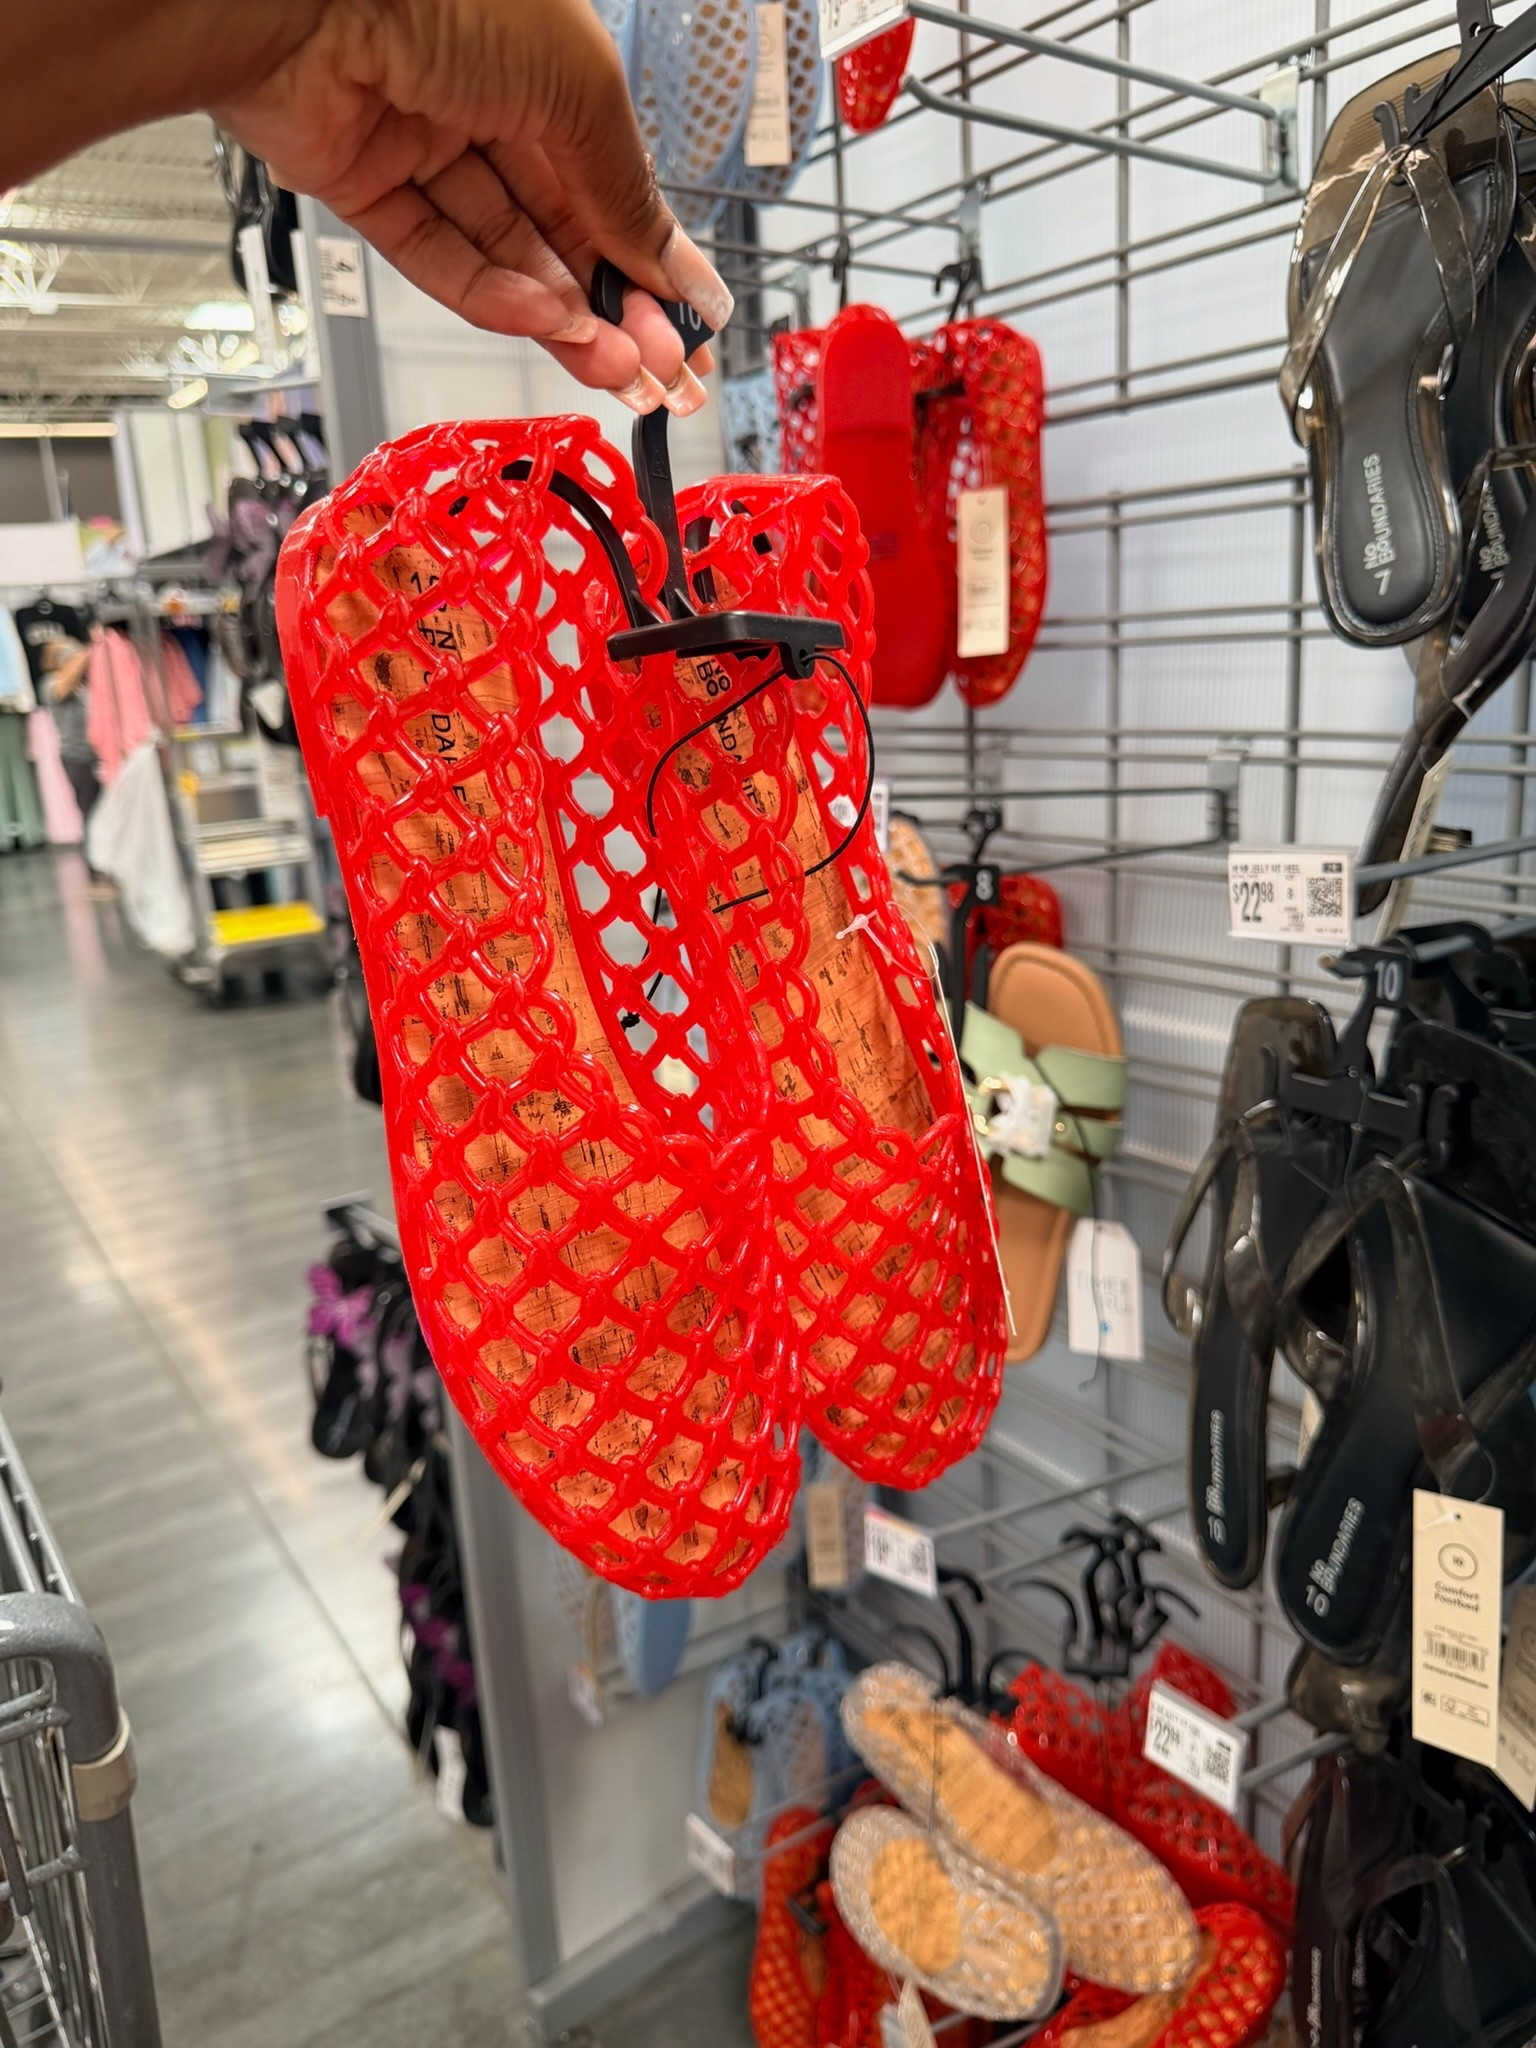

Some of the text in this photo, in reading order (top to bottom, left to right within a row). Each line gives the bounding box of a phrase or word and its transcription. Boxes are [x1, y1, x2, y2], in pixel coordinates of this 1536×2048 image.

[1363, 453, 1396, 566] BOUNDARIES
[1363, 542, 1379, 570] NO
[1374, 568, 1392, 596] 7
[1374, 959, 1399, 1001] 10
[1207, 1515, 1227, 1546] 10
[1306, 1585, 1330, 1618] 10
[1434, 1580, 1480, 1601] Comfort
